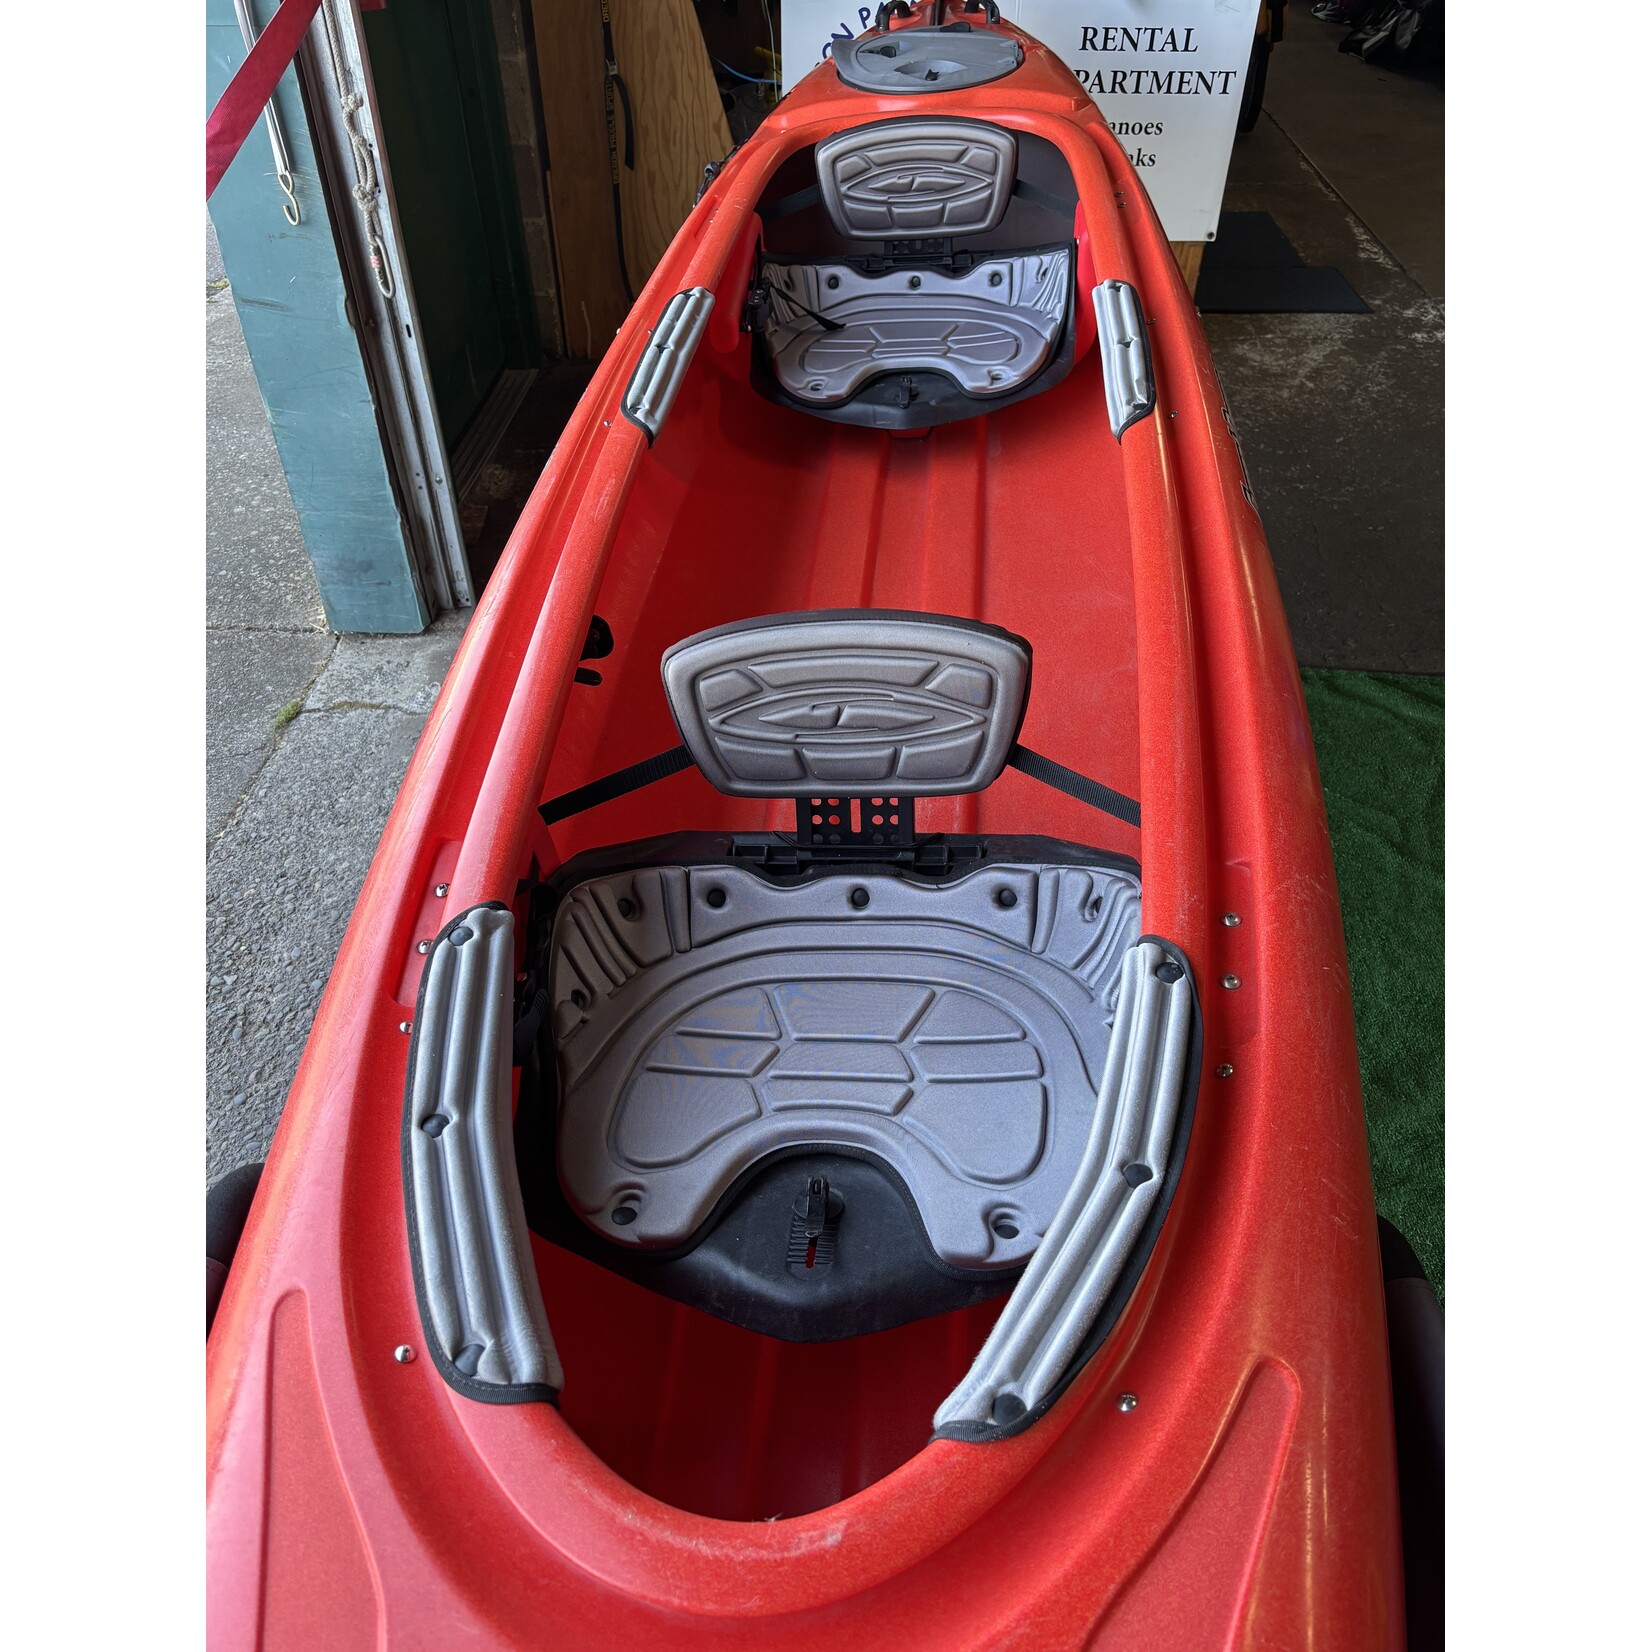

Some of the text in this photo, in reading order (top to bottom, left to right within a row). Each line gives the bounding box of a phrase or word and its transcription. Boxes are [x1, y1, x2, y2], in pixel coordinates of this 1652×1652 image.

[1078, 26, 1199, 53] RENTAL
[1073, 69, 1237, 95] PARTMENT
[608, 114, 617, 149] PADDLE
[1108, 121, 1164, 136] anoes
[610, 150, 620, 185] OREGON
